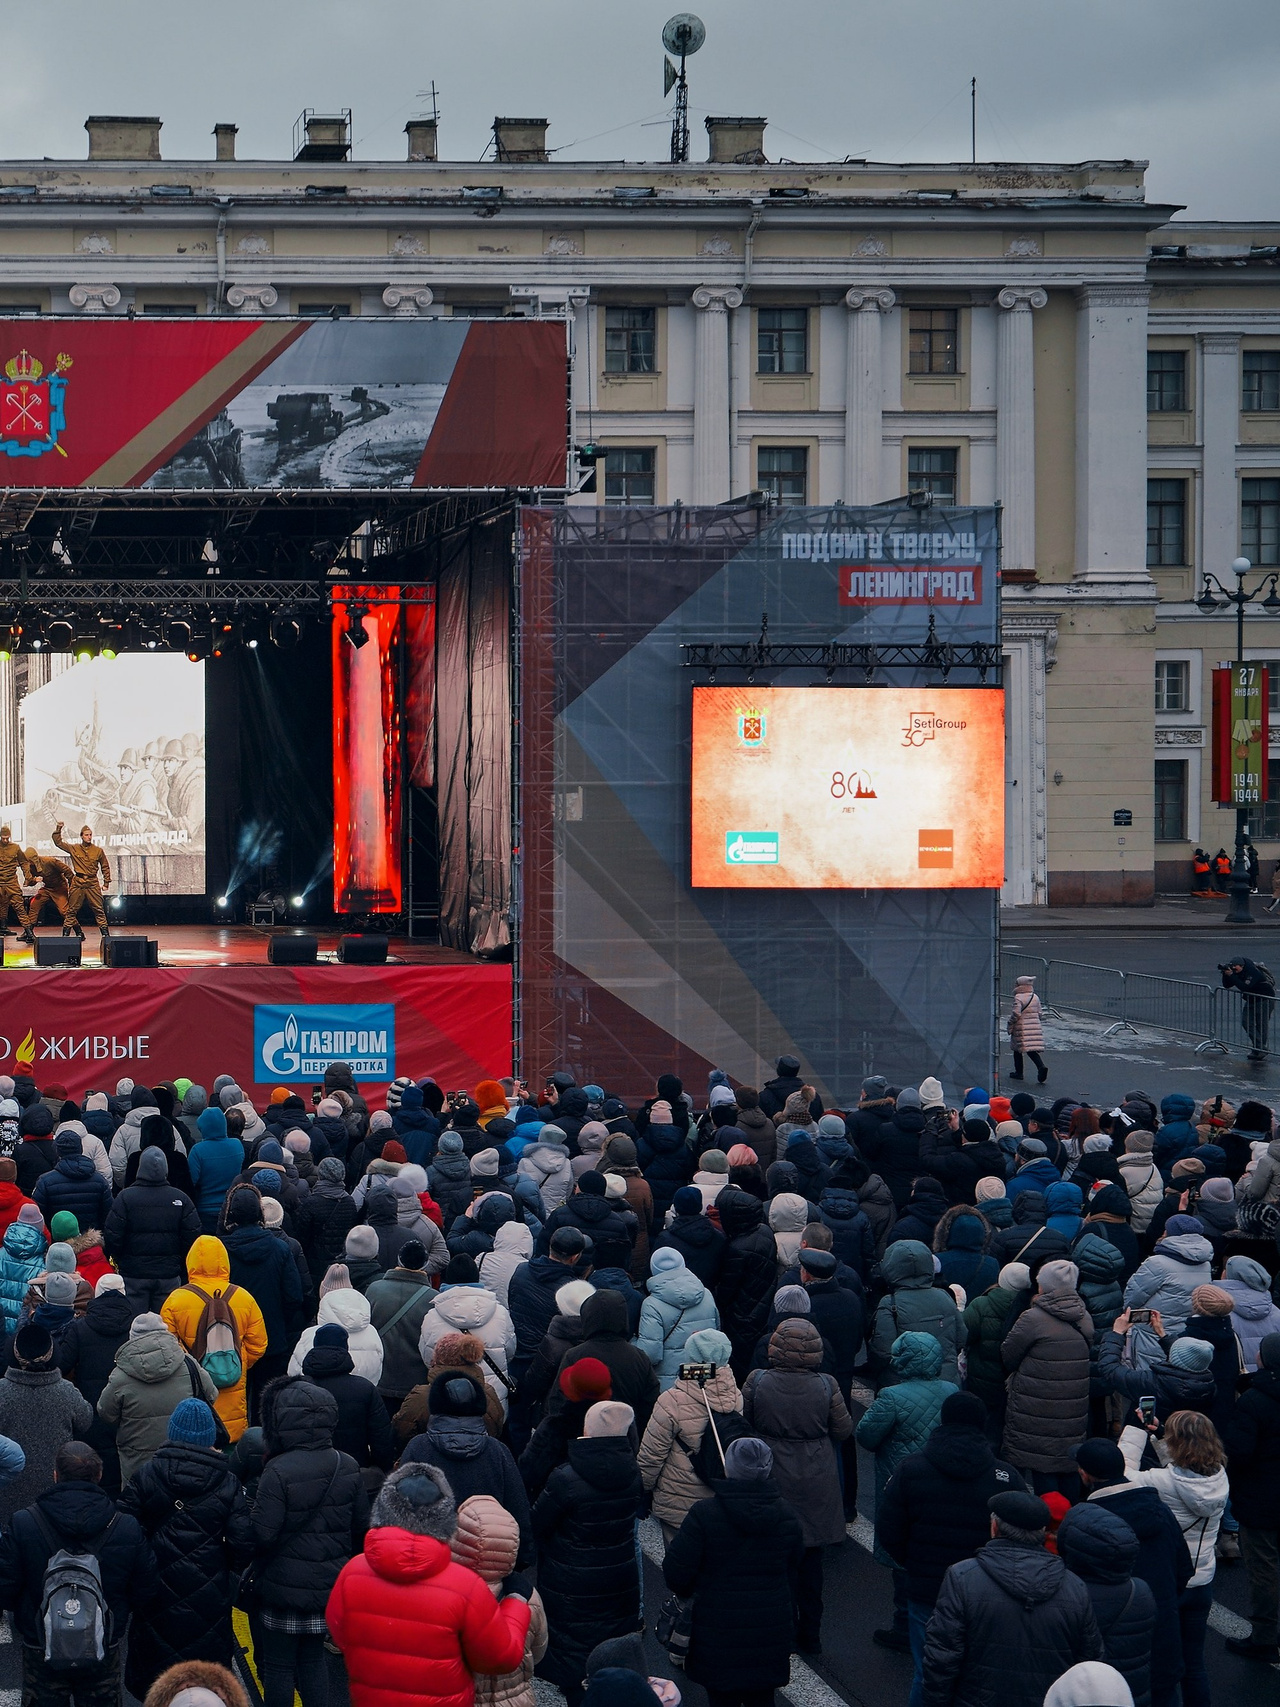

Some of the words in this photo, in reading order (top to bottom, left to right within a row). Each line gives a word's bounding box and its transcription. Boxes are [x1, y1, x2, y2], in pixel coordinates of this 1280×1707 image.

[782, 533, 883, 562] ПОДВИГУ
[889, 533, 982, 562] ТВОЕМУ,
[848, 571, 975, 601] ЛЕНИНГРАД
[1239, 668, 1255, 685] 27
[1234, 687, 1259, 697] ЯНВАРЯ
[1234, 773, 1259, 787] 1941
[1234, 789, 1259, 803] 1944
[39, 1035, 150, 1060] ЖИВЫЕ
[301, 1030, 387, 1054] ГАЗПРОМ
[304, 1061, 384, 1072] ПЕРБОТКА
